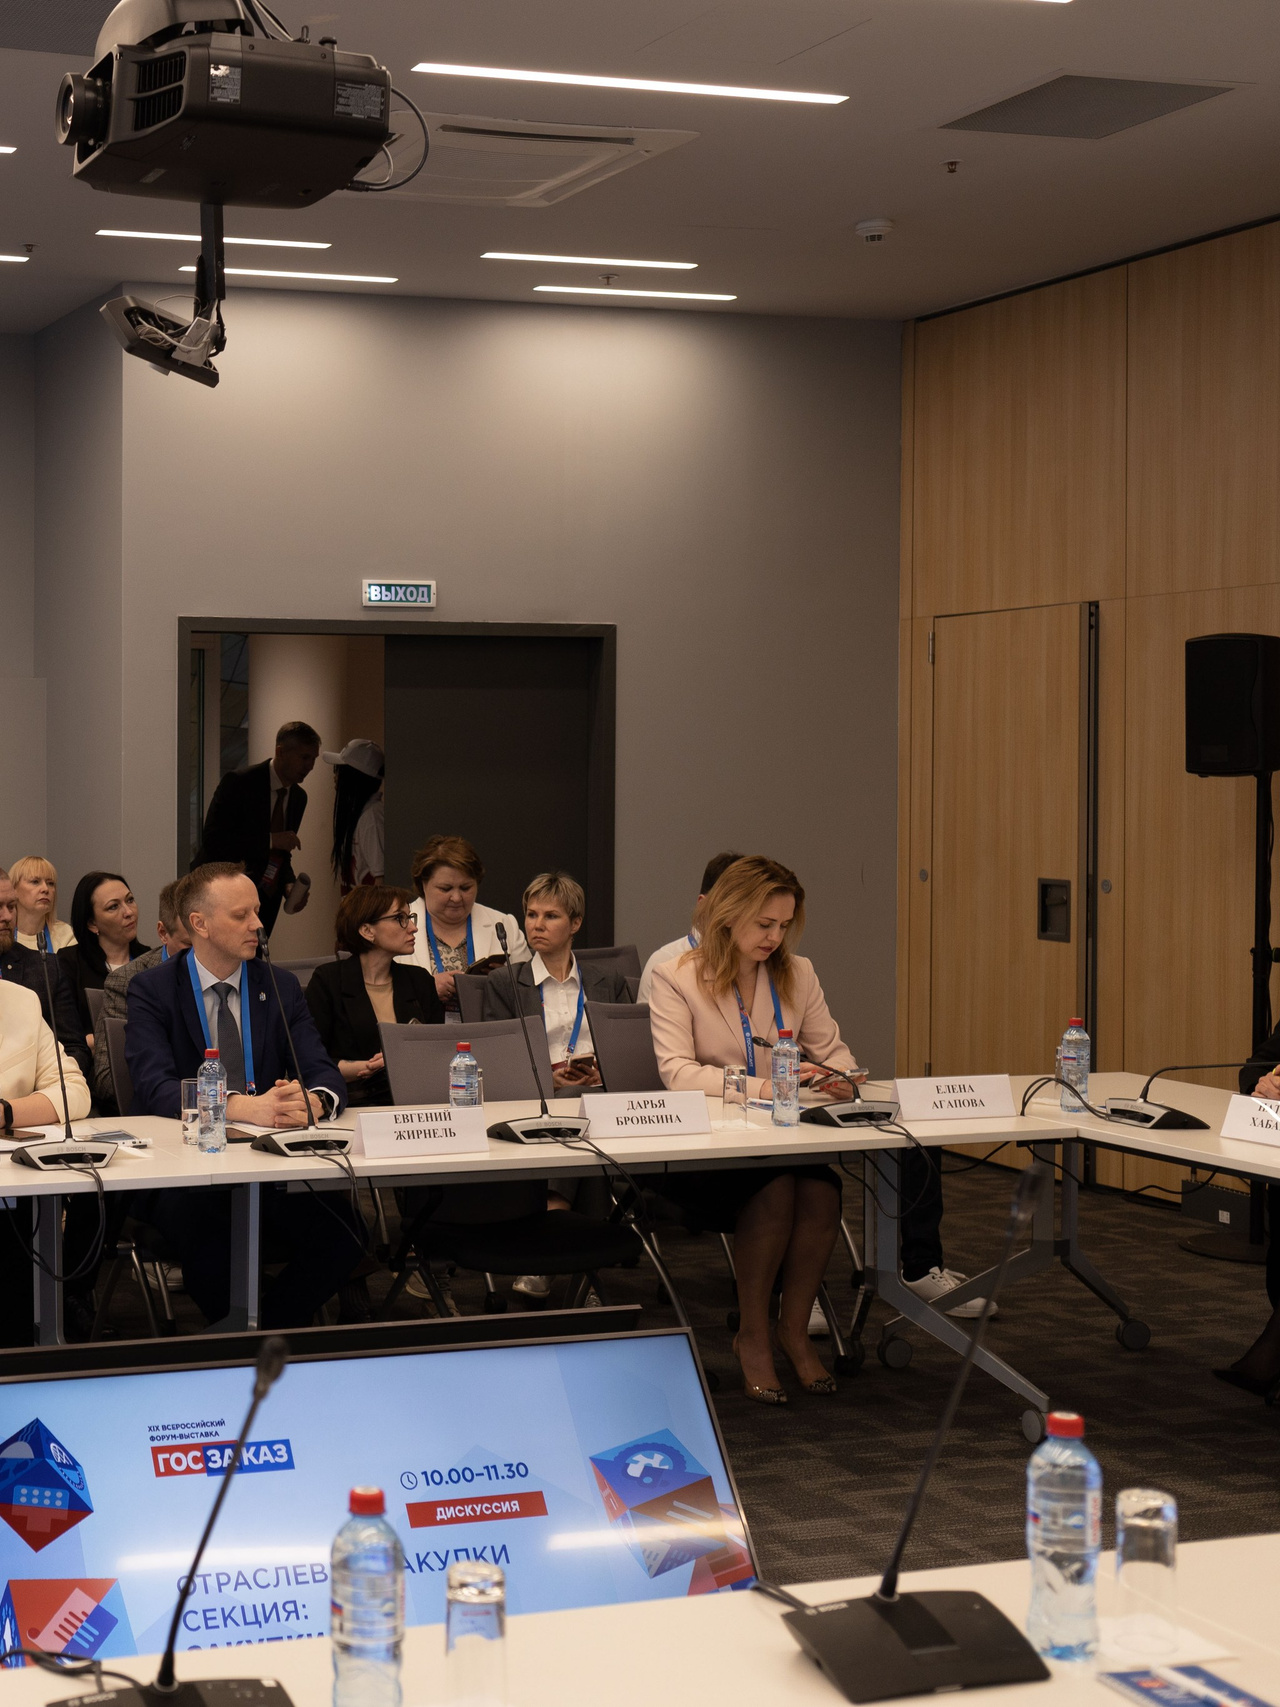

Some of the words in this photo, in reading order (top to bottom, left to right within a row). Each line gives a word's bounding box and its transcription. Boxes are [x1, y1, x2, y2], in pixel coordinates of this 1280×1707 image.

[370, 585, 429, 603] ВЫХОД
[935, 1084, 975, 1095] ЕЛЕНА
[626, 1099, 666, 1111] ДАРЬЯ
[931, 1098, 985, 1110] АГАПОВА
[394, 1109, 452, 1124] ЕВГЕНИЙ
[615, 1114, 682, 1126] БРОВКИНА
[393, 1127, 456, 1141] ЖИРНЕЛЬ
[161, 1418, 226, 1431] ВСЕРОССИЙСКИЙ
[149, 1430, 220, 1442] ФОРУМ-ВЫСТАВКА
[436, 1500, 520, 1521] ДИСКУССИЯ
[176, 1562, 330, 1597] ОТРАСЛЕВ
[404, 1544, 510, 1574] АКУПКИ
[182, 1600, 309, 1632] СЕКЦИЯ:
